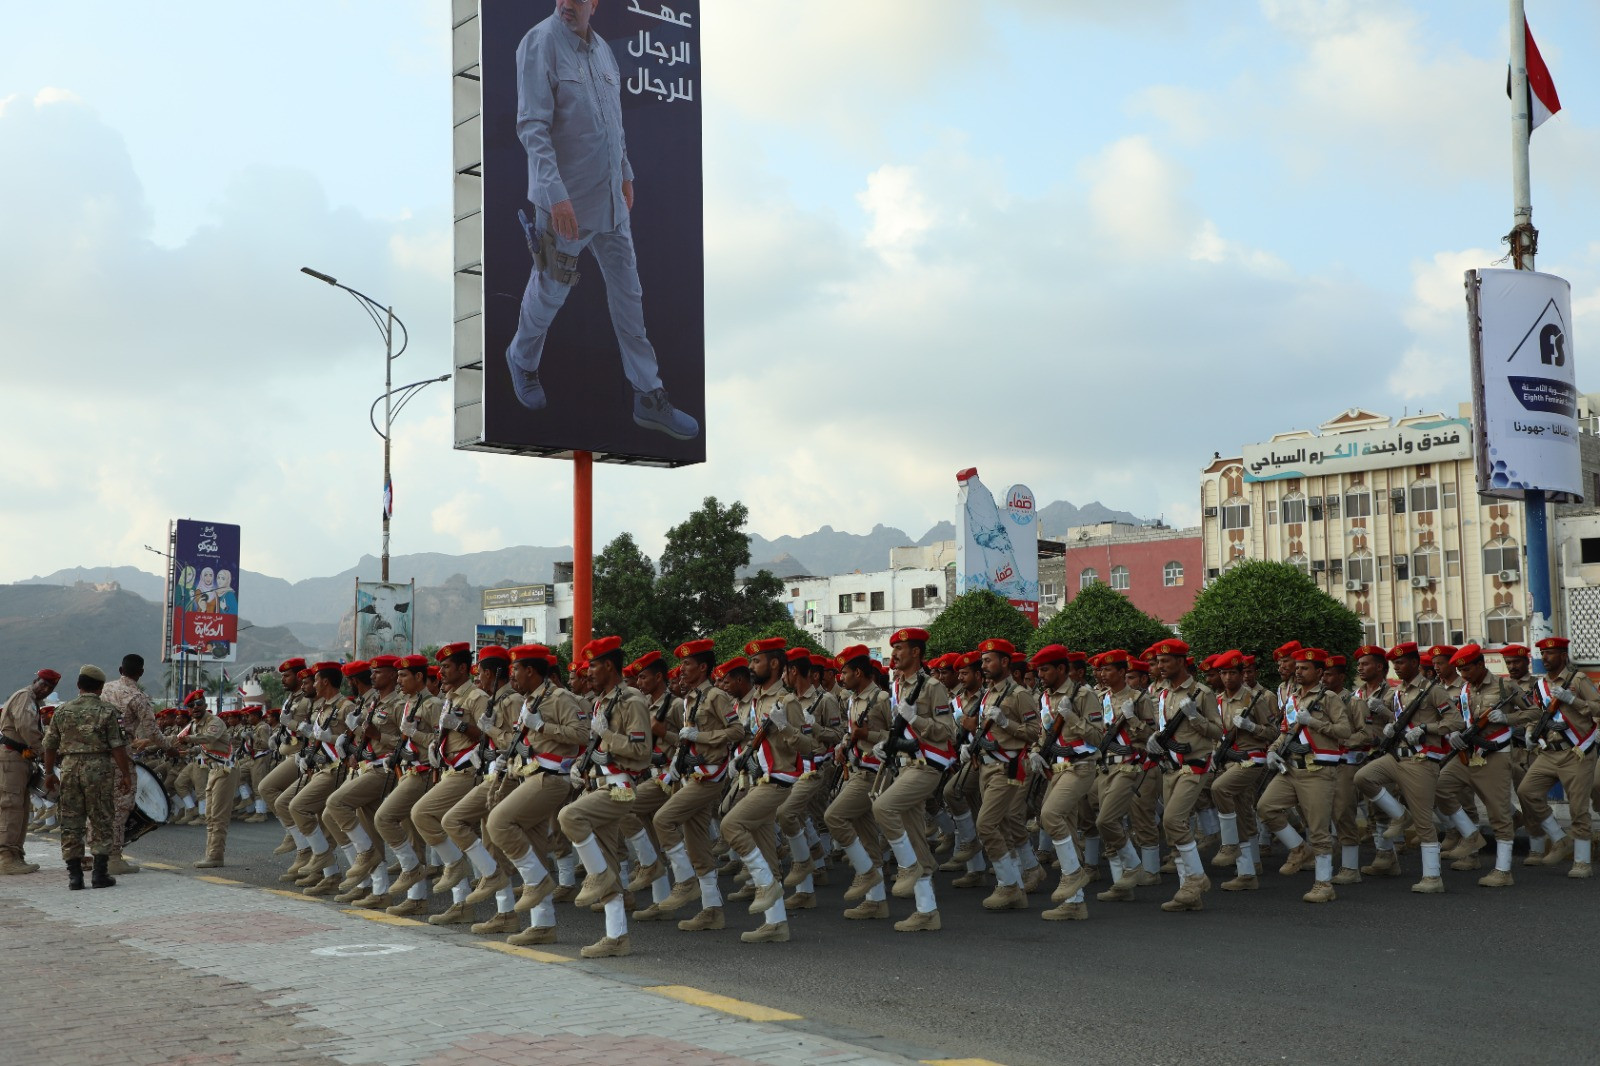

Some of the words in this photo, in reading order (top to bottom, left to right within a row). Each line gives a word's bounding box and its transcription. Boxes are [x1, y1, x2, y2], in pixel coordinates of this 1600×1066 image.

[627, 0, 692, 28] عهد
[627, 29, 690, 66] الرجال
[626, 66, 693, 103] للرجال
[1523, 393, 1545, 403] Eighth
[1416, 430, 1460, 451] فندق
[1513, 421, 1545, 437] جهودنا
[1309, 441, 1358, 465] الكرم
[1361, 433, 1414, 457] وأجنحة
[1250, 448, 1306, 475] السياحي
[197, 539, 219, 553] شوكو
[193, 620, 224, 639] الحكاية
